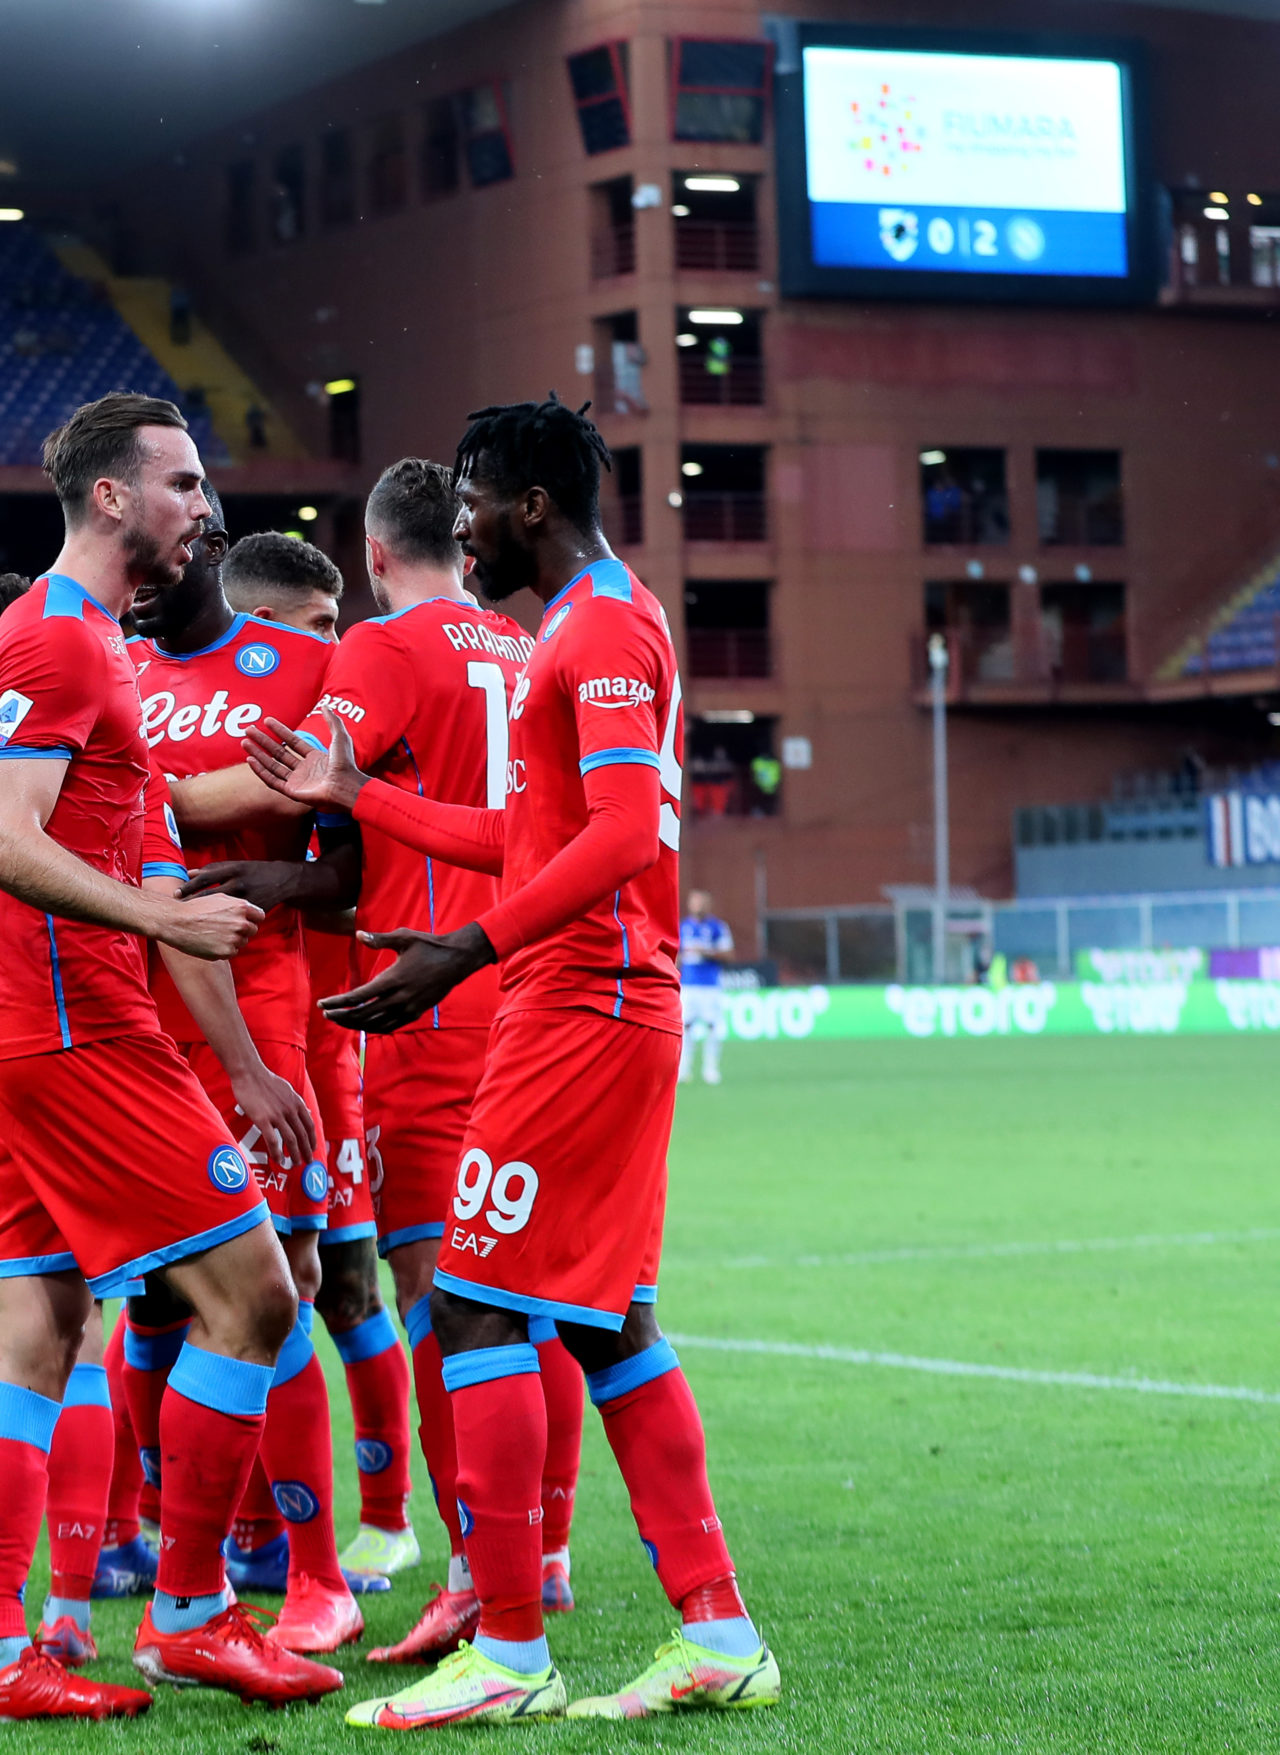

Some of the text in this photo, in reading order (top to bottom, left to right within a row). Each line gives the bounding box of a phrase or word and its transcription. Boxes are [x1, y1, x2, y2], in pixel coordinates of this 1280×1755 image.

[972, 219, 999, 256] 2
[577, 676, 656, 705] amazon
[453, 1147, 540, 1235] 99
[451, 1226, 499, 1258] EA7
[58, 1522, 96, 1540] EA7
